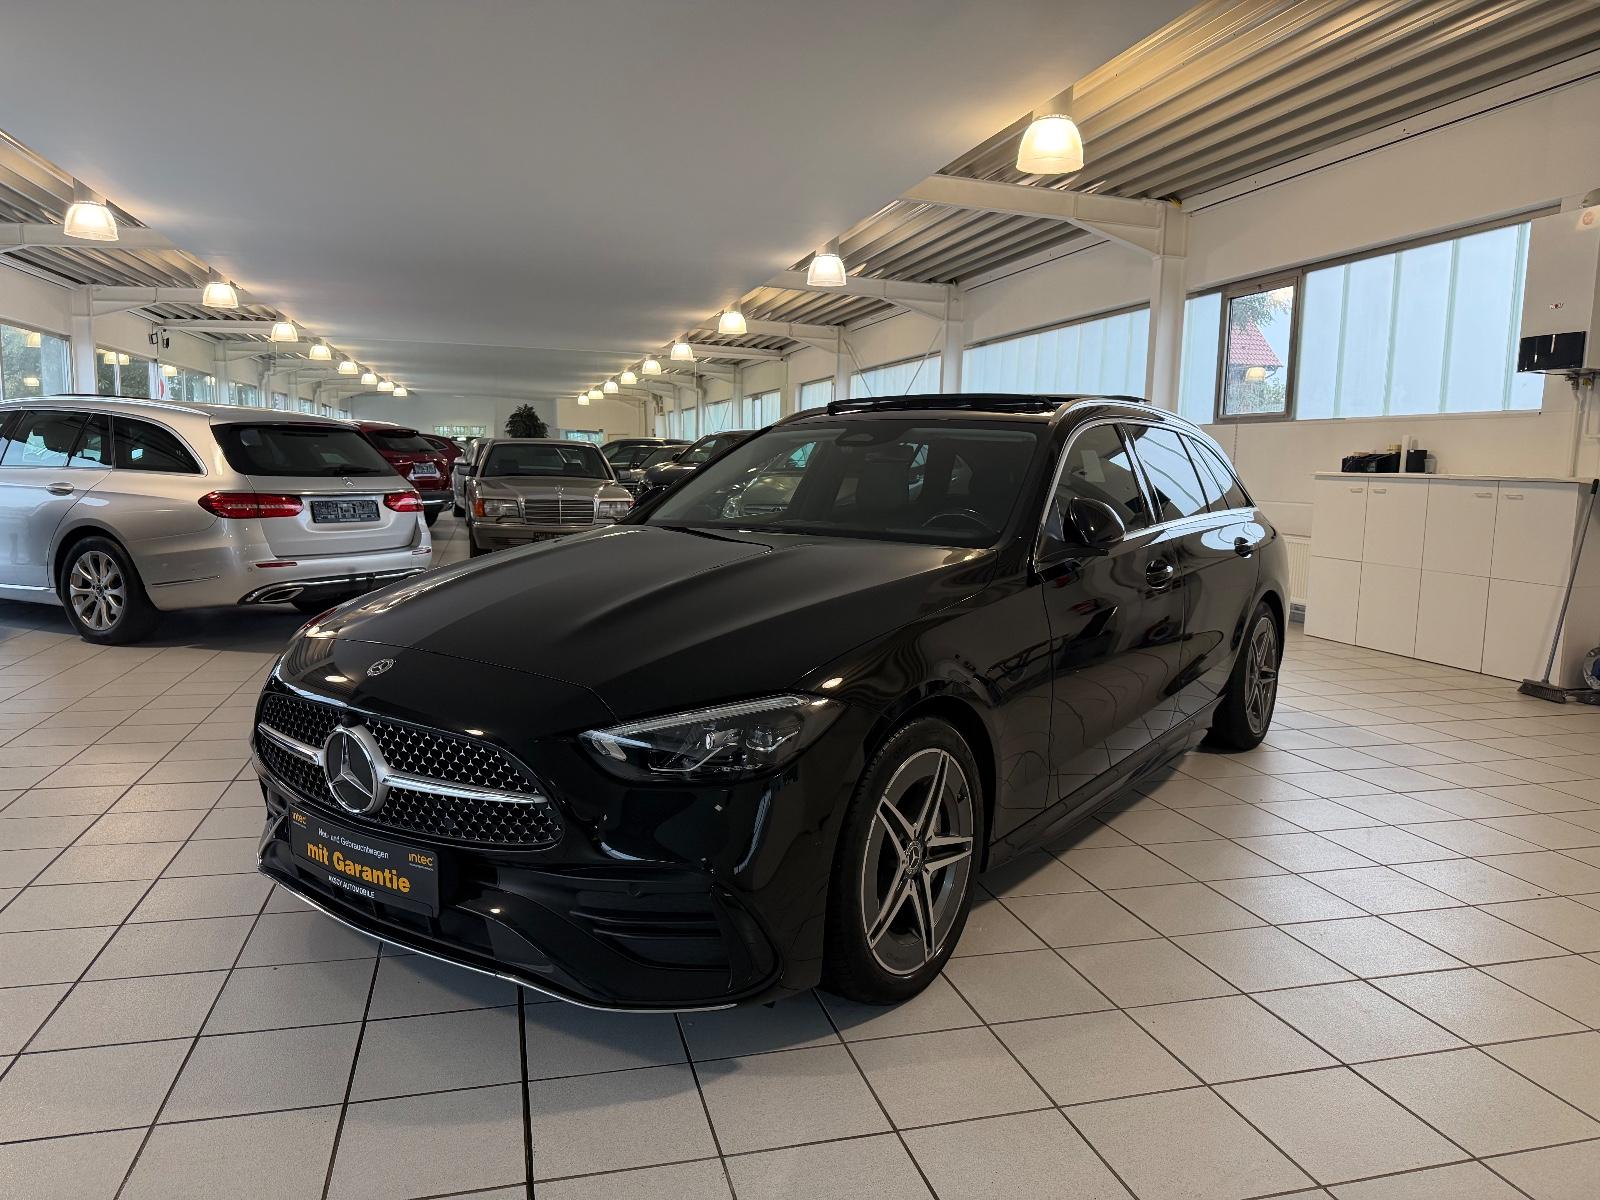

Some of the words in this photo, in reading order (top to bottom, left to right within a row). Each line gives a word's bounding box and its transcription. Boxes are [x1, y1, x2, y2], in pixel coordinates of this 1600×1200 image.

[307, 841, 330, 867] mit
[332, 850, 411, 893] Garantie
[408, 852, 434, 867] intec
[342, 881, 376, 899] AUTOMOBILE
